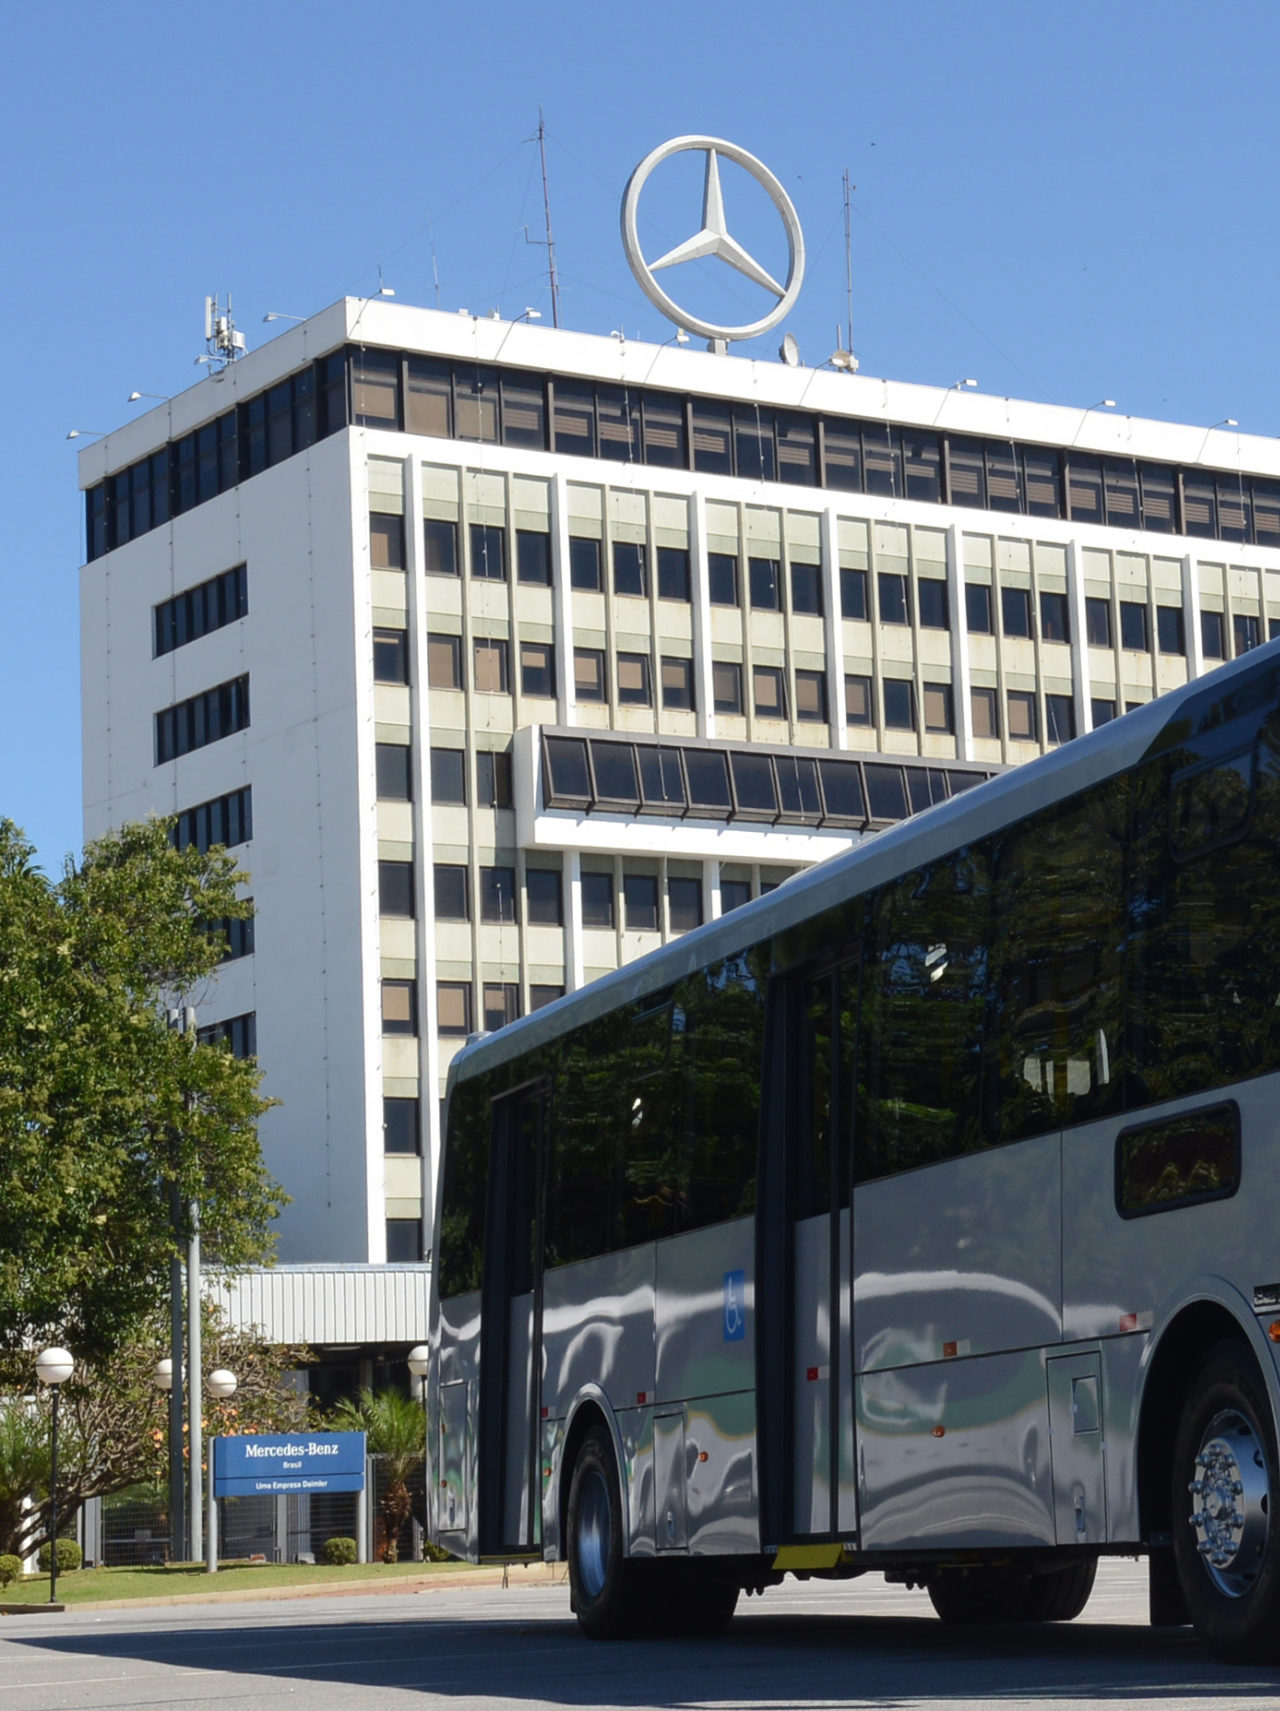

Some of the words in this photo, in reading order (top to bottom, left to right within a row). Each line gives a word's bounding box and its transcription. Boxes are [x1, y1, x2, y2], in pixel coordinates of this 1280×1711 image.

[245, 1442, 339, 1458] Mercedes-Benz
[283, 1461, 302, 1469] Brasil
[256, 1482, 272, 1490] Uma
[273, 1480, 301, 1490] Empresa
[302, 1480, 328, 1488] Daimler
